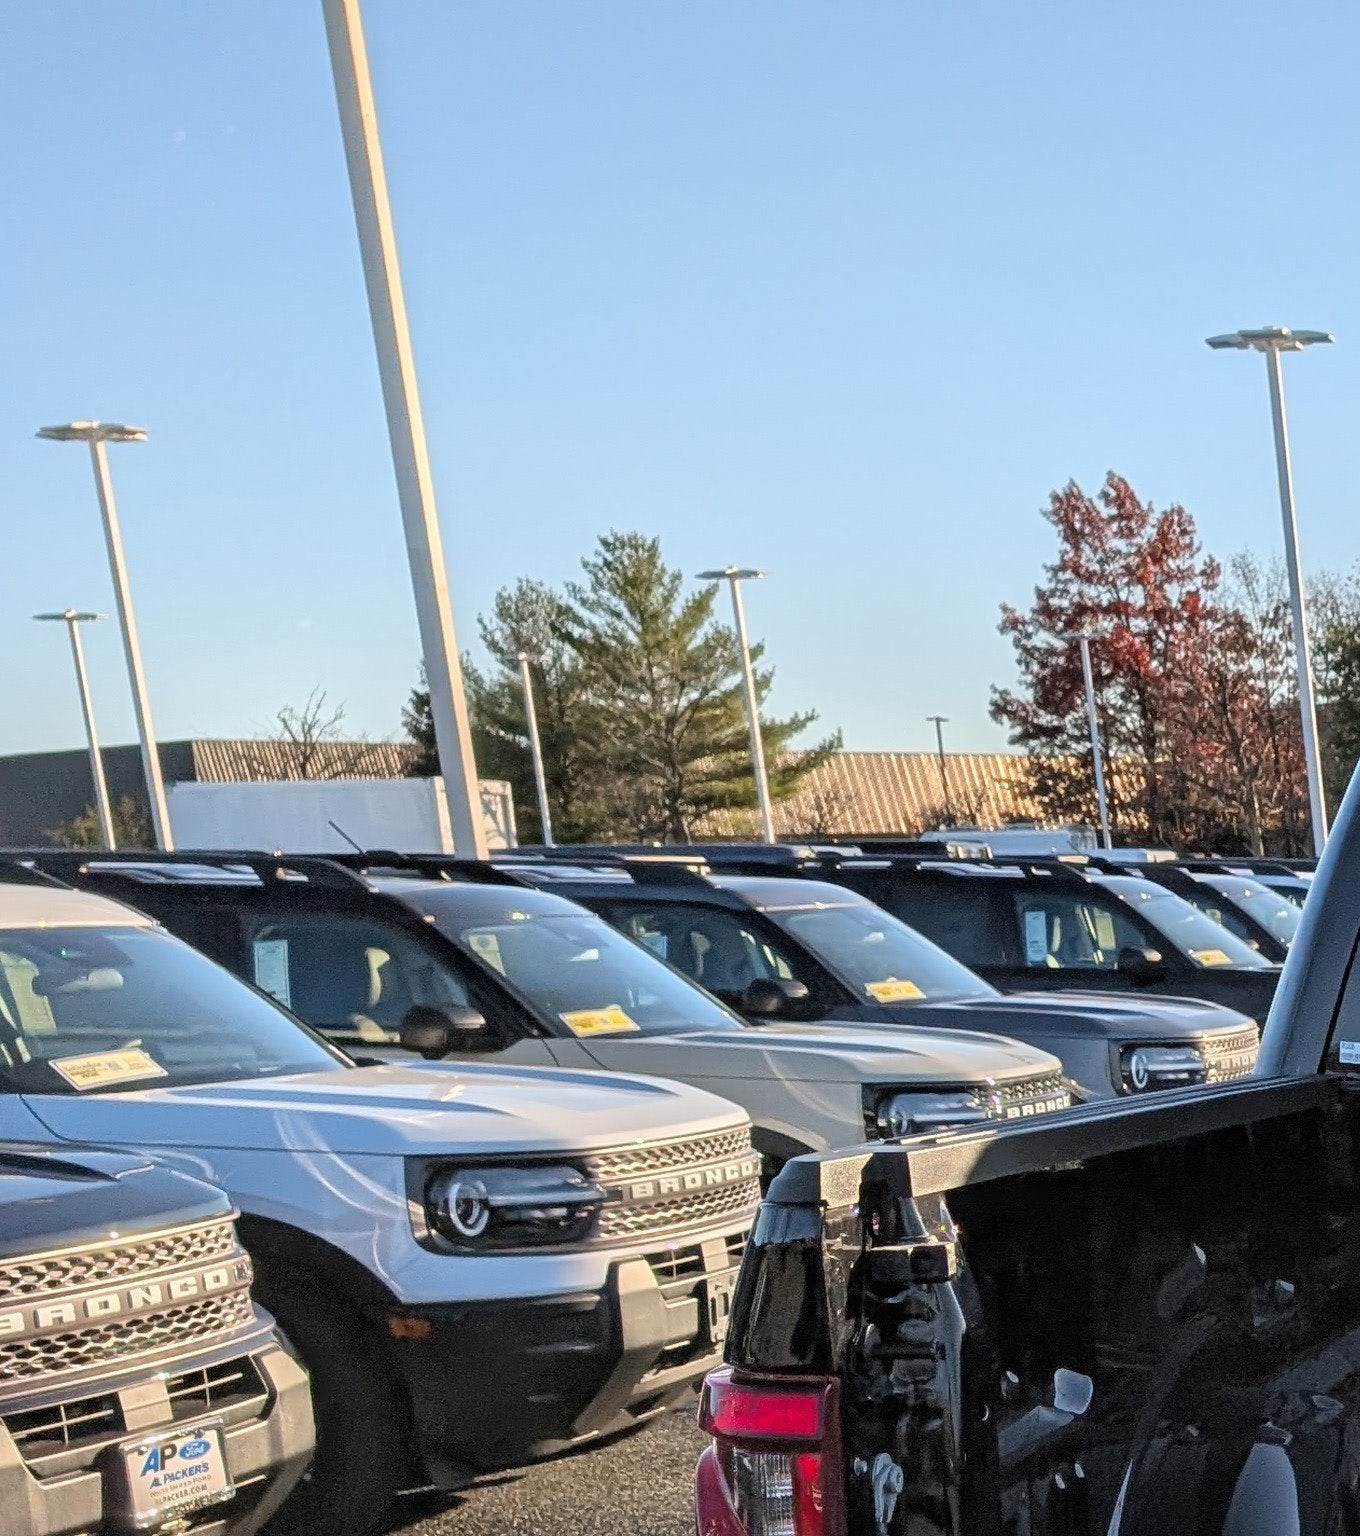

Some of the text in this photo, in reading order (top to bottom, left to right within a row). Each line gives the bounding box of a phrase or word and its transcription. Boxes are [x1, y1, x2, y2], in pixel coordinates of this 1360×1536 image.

[1006, 1093, 1071, 1119] BRONCO
[631, 1160, 753, 1199] BRONCO
[0, 1268, 229, 1335] BRONCO
[140, 1443, 178, 1477] AP
